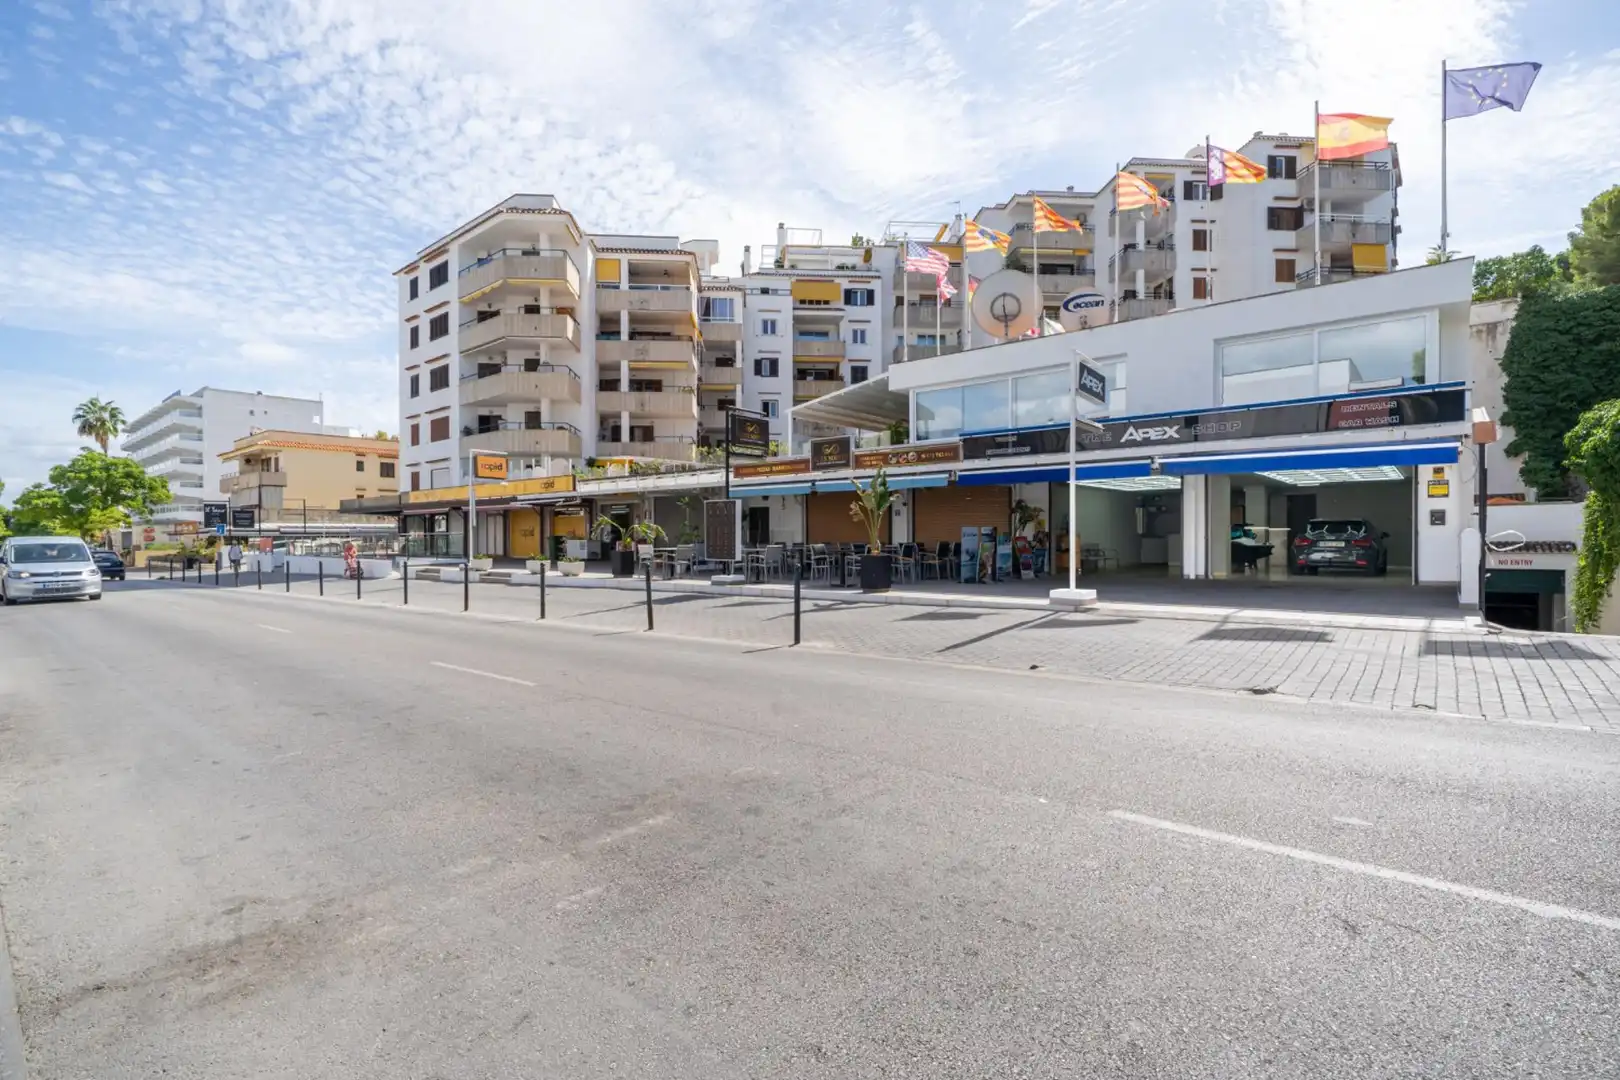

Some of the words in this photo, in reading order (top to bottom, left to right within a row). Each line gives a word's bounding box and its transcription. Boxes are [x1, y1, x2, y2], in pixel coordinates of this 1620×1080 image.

[1081, 368, 1104, 397] APEX
[1120, 425, 1180, 442] APEX
[1192, 421, 1242, 435] SHOP
[1510, 559, 1534, 567] ENTRY
